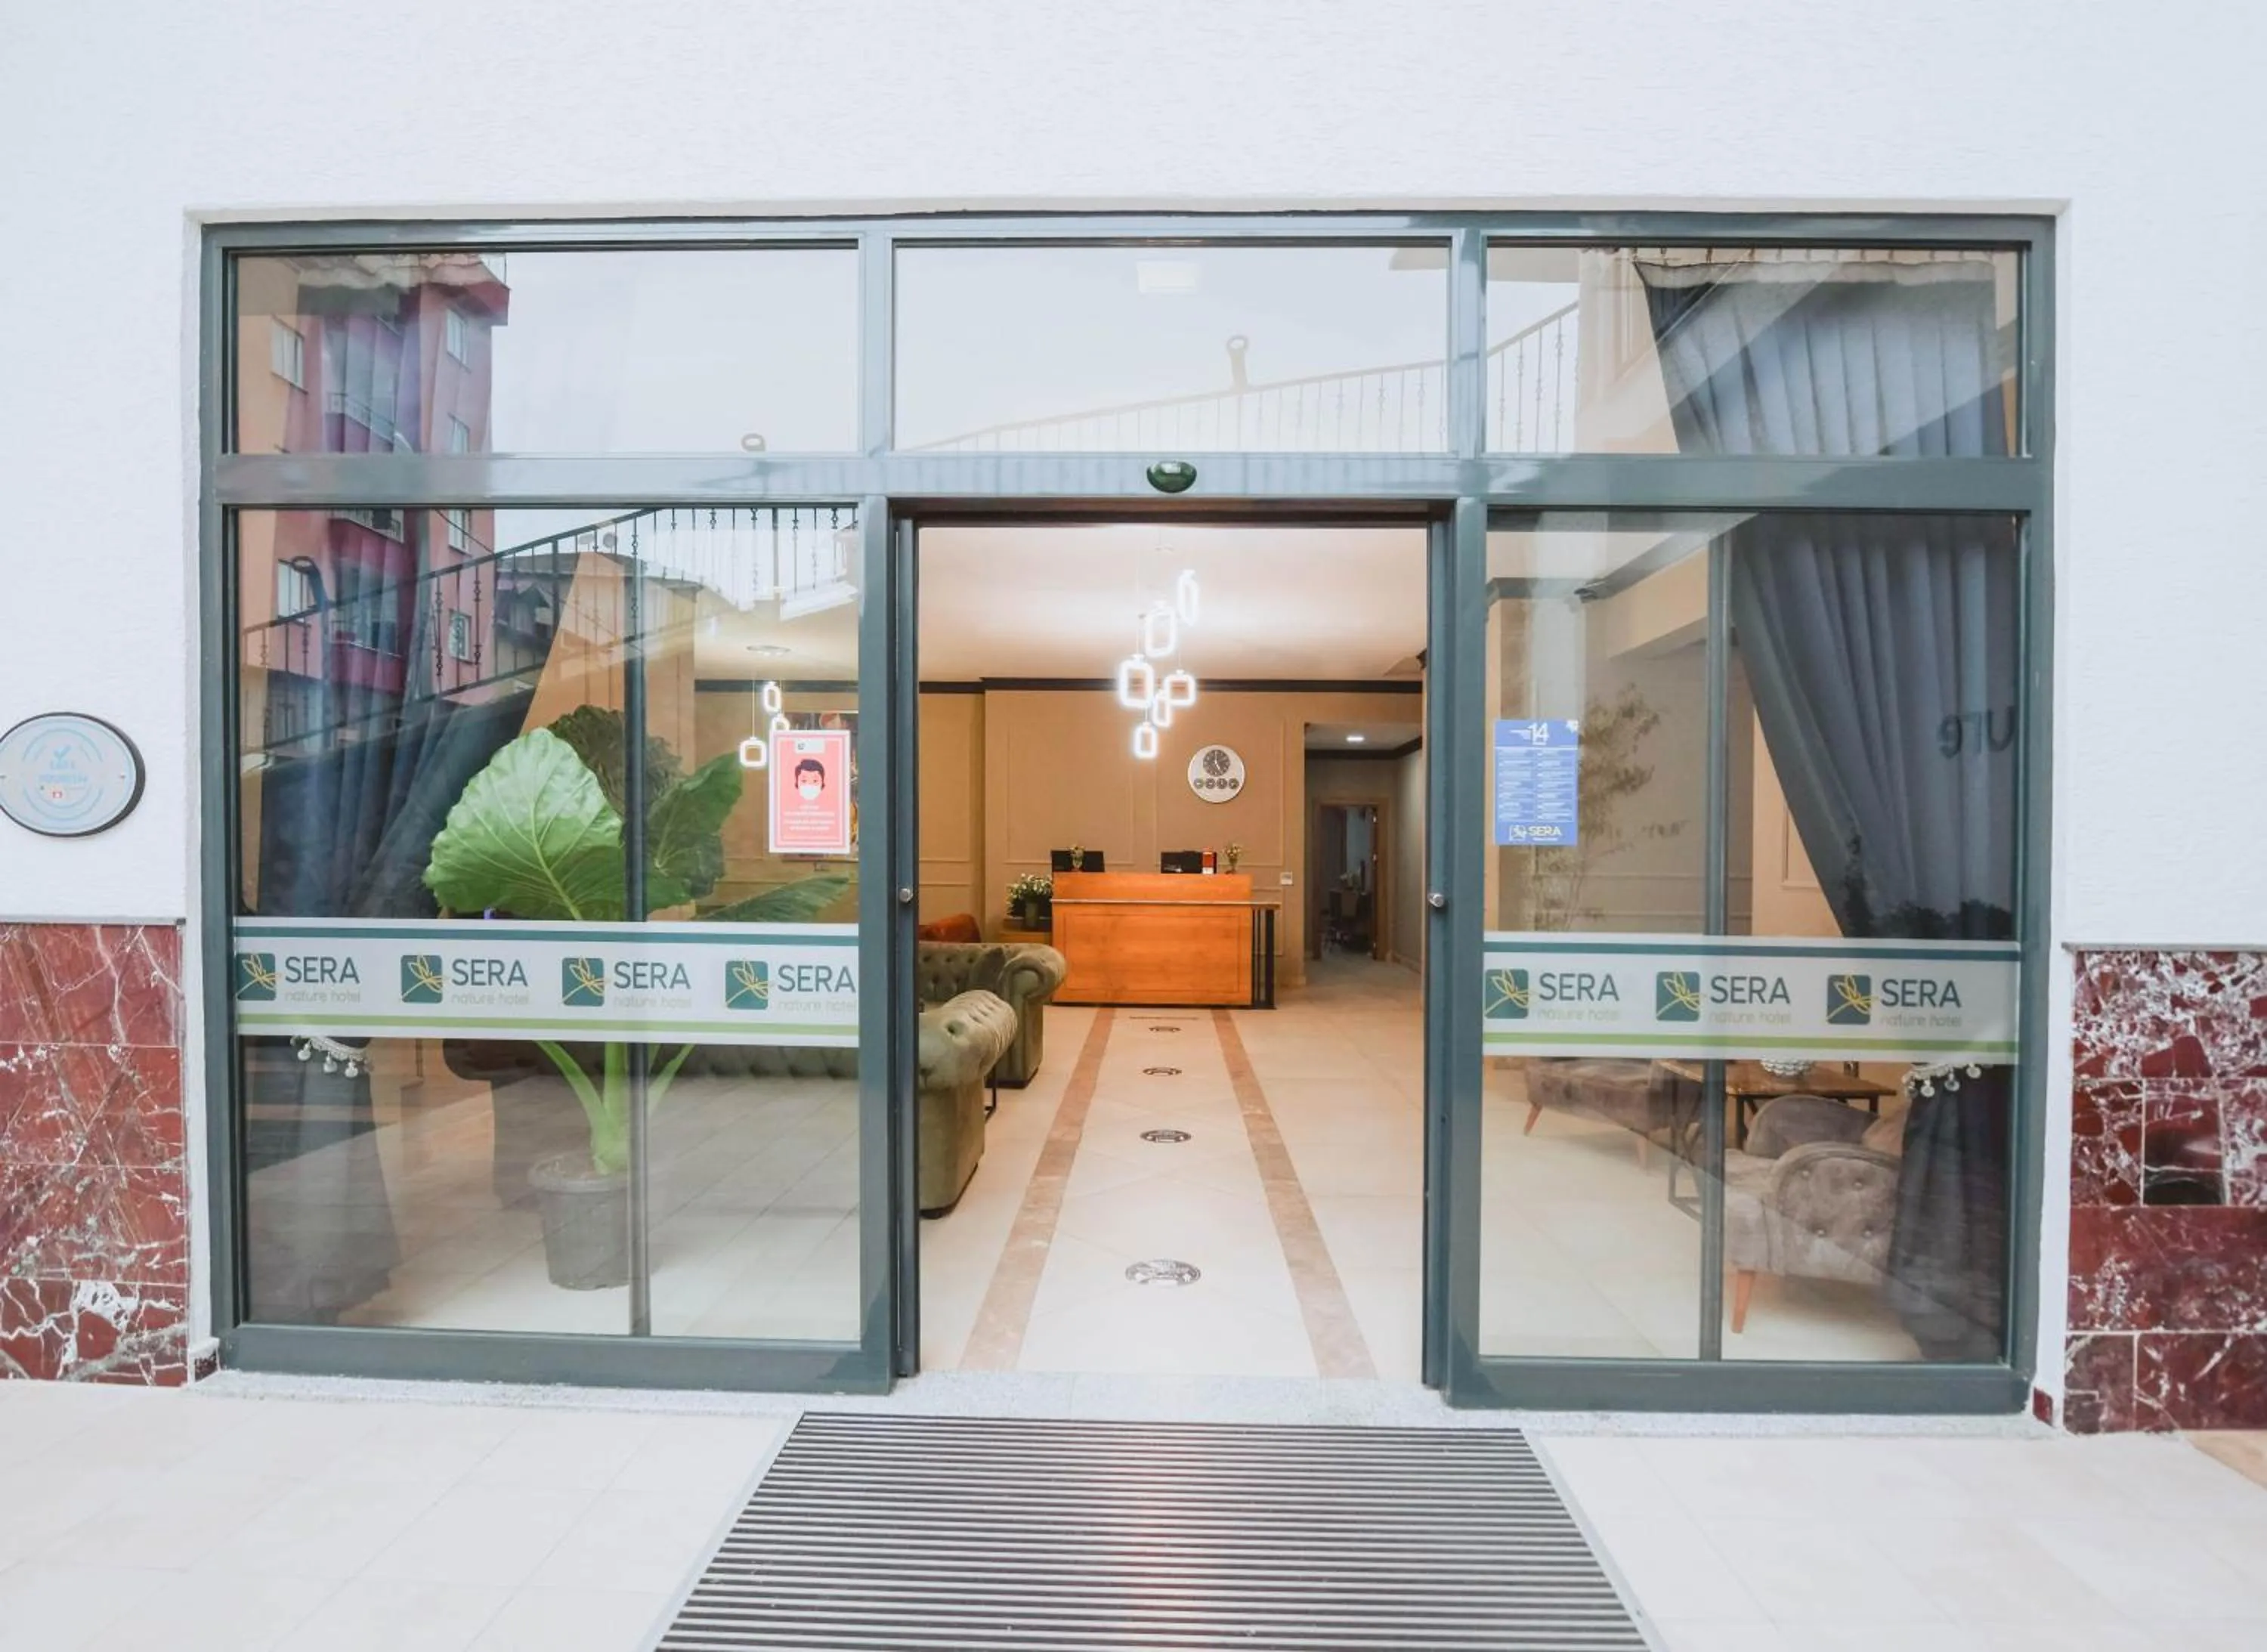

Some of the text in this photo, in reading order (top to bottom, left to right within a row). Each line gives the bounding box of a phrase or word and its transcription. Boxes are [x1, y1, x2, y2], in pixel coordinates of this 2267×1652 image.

[1529, 722, 1549, 741] 14
[1528, 825, 1562, 837] SERA
[285, 956, 360, 984] SERA
[451, 959, 528, 987] SERA
[613, 961, 691, 989] SERA
[777, 965, 856, 992] SERA
[284, 989, 361, 1004] nature hotel
[1539, 973, 1620, 1001] SERA
[1709, 976, 1791, 1005] SERA
[1881, 979, 1962, 1008] SERA
[451, 992, 530, 1006] nature hotel
[613, 995, 692, 1009] nature hotel
[1709, 1010, 1792, 1024] nature hotel
[1880, 1013, 1962, 1029] nature hotel
